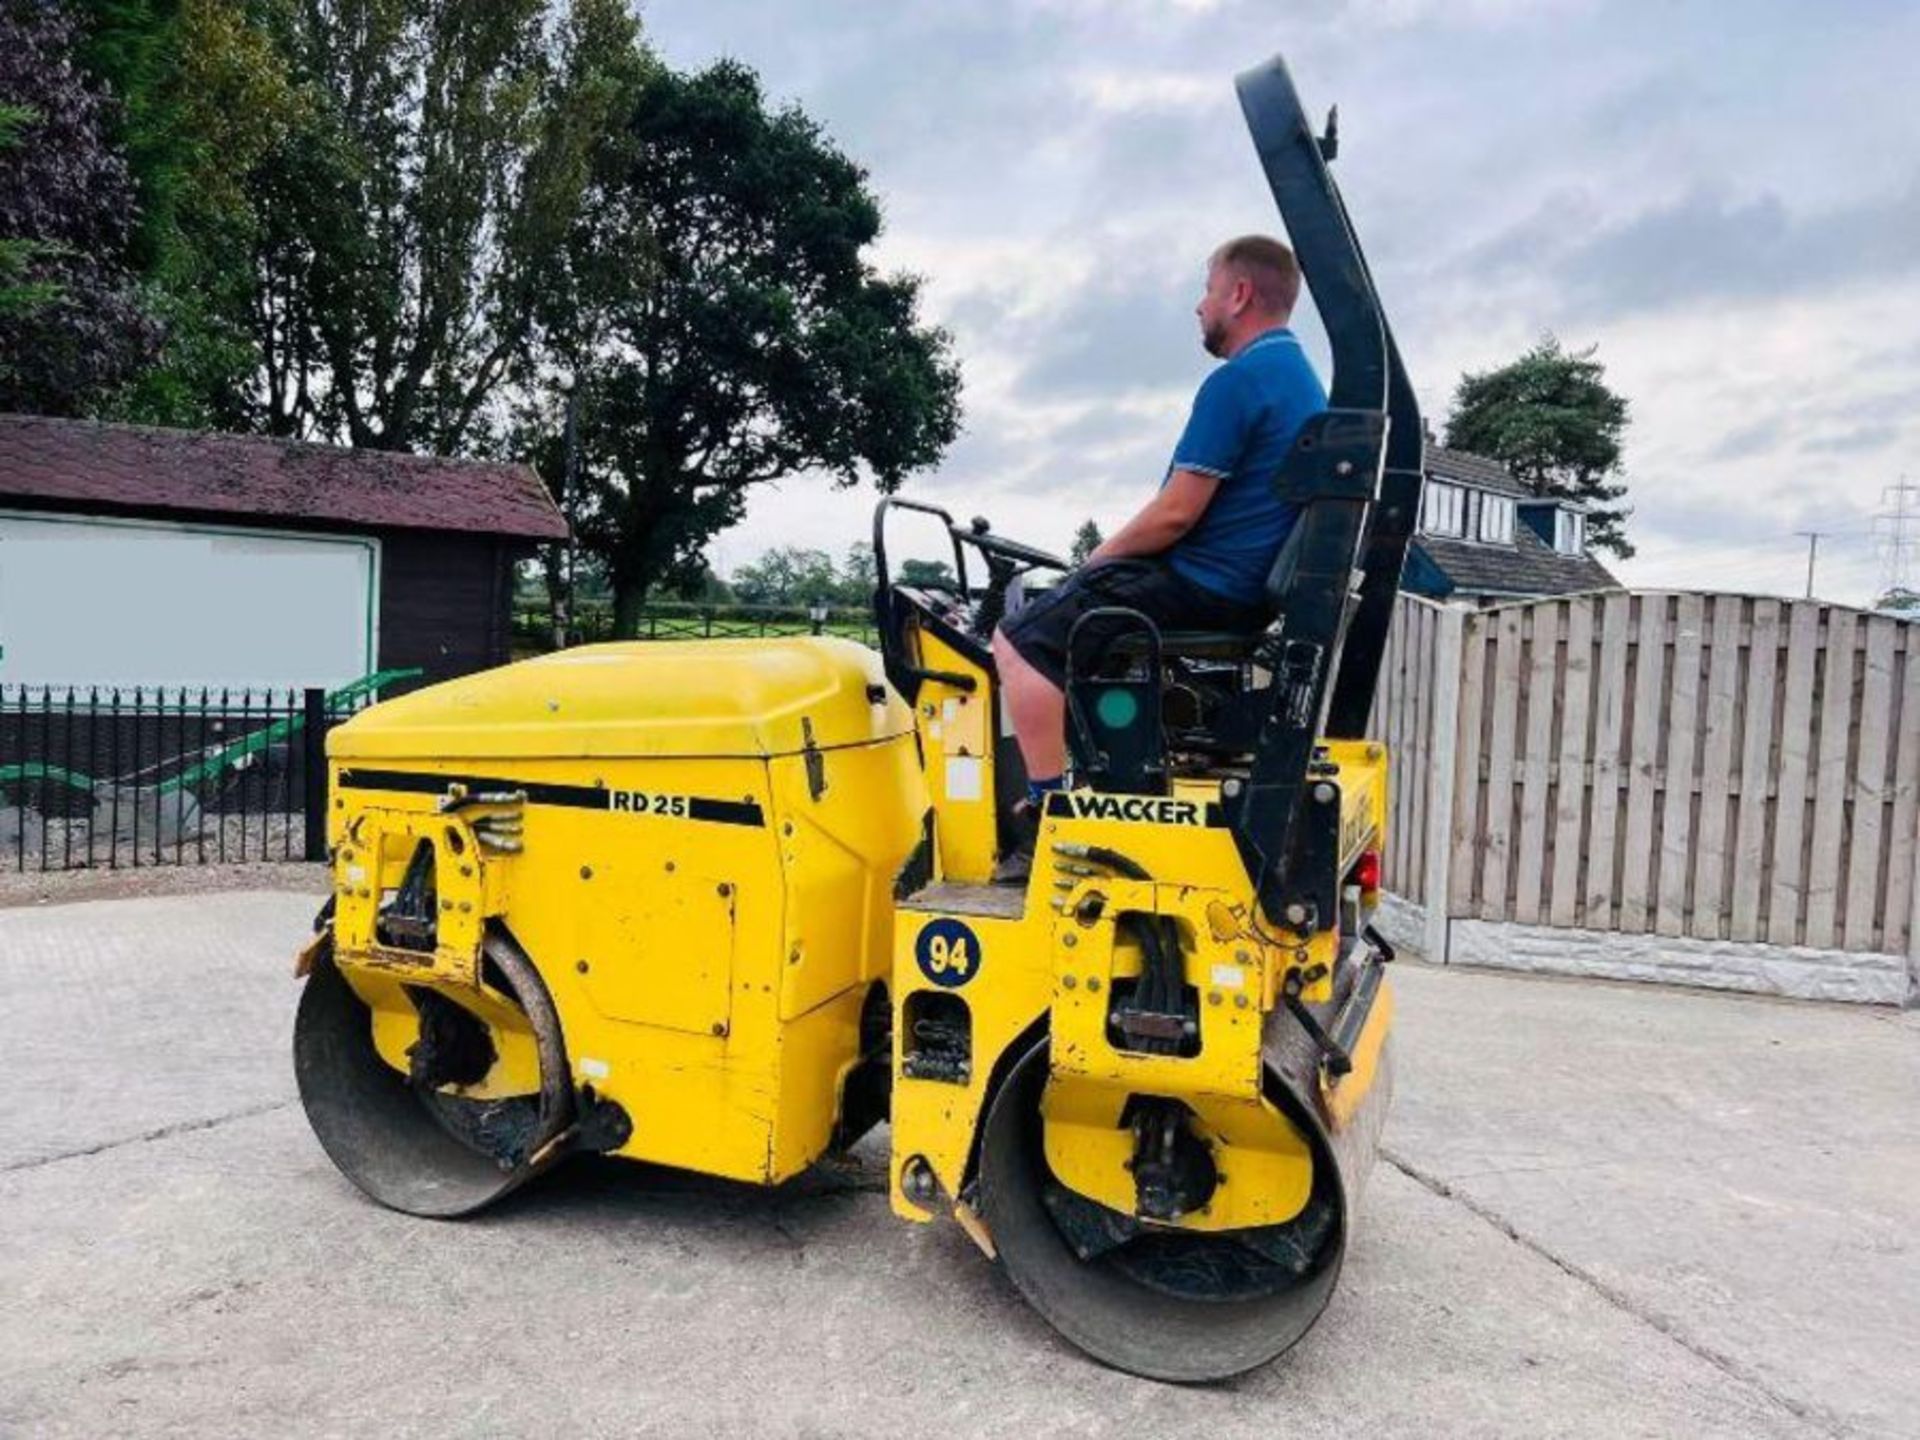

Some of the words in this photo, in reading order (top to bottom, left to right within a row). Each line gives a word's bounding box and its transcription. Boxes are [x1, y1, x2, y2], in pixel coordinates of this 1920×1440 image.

[614, 791, 648, 812] RD
[654, 794, 685, 816] 25
[1075, 795, 1198, 826] WACKER
[930, 935, 968, 975] 94
